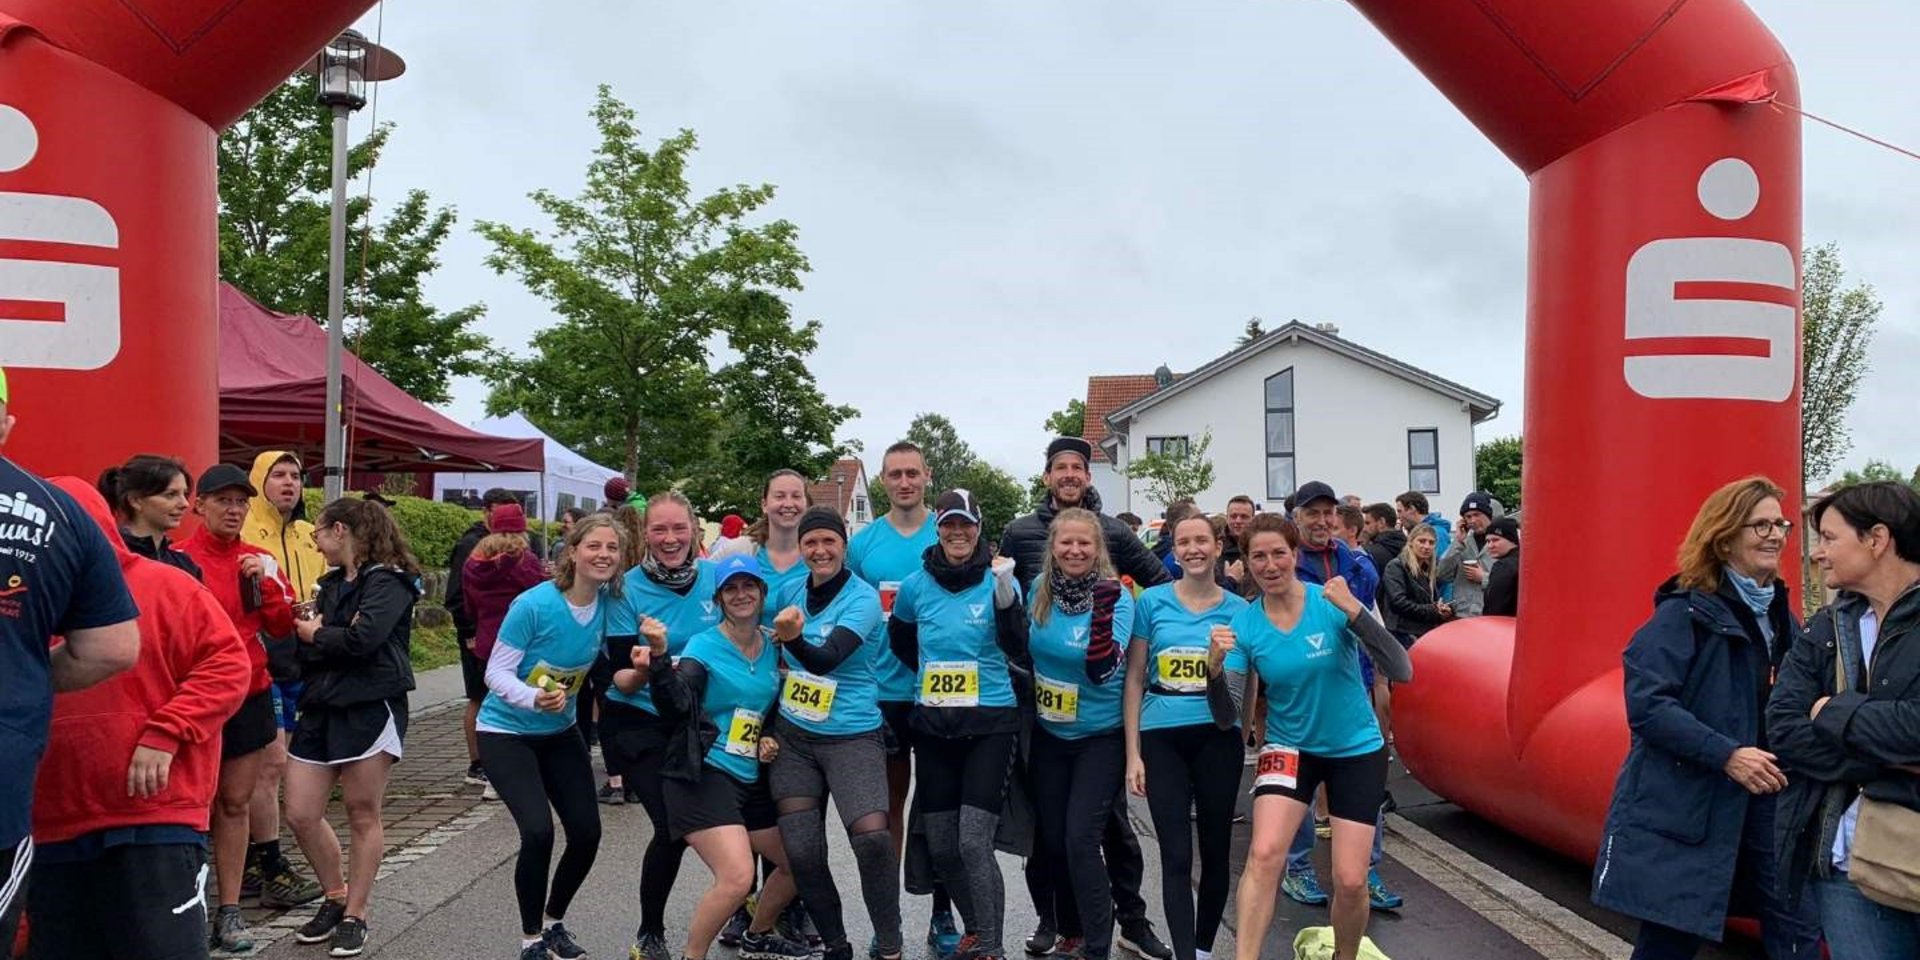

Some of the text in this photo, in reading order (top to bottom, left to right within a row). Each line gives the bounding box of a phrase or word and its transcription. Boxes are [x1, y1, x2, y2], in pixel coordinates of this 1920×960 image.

[15, 548, 36, 563] 1912
[1169, 659, 1206, 679] 250
[930, 674, 966, 692] 282
[790, 682, 821, 707] 254
[1036, 686, 1063, 710] 281
